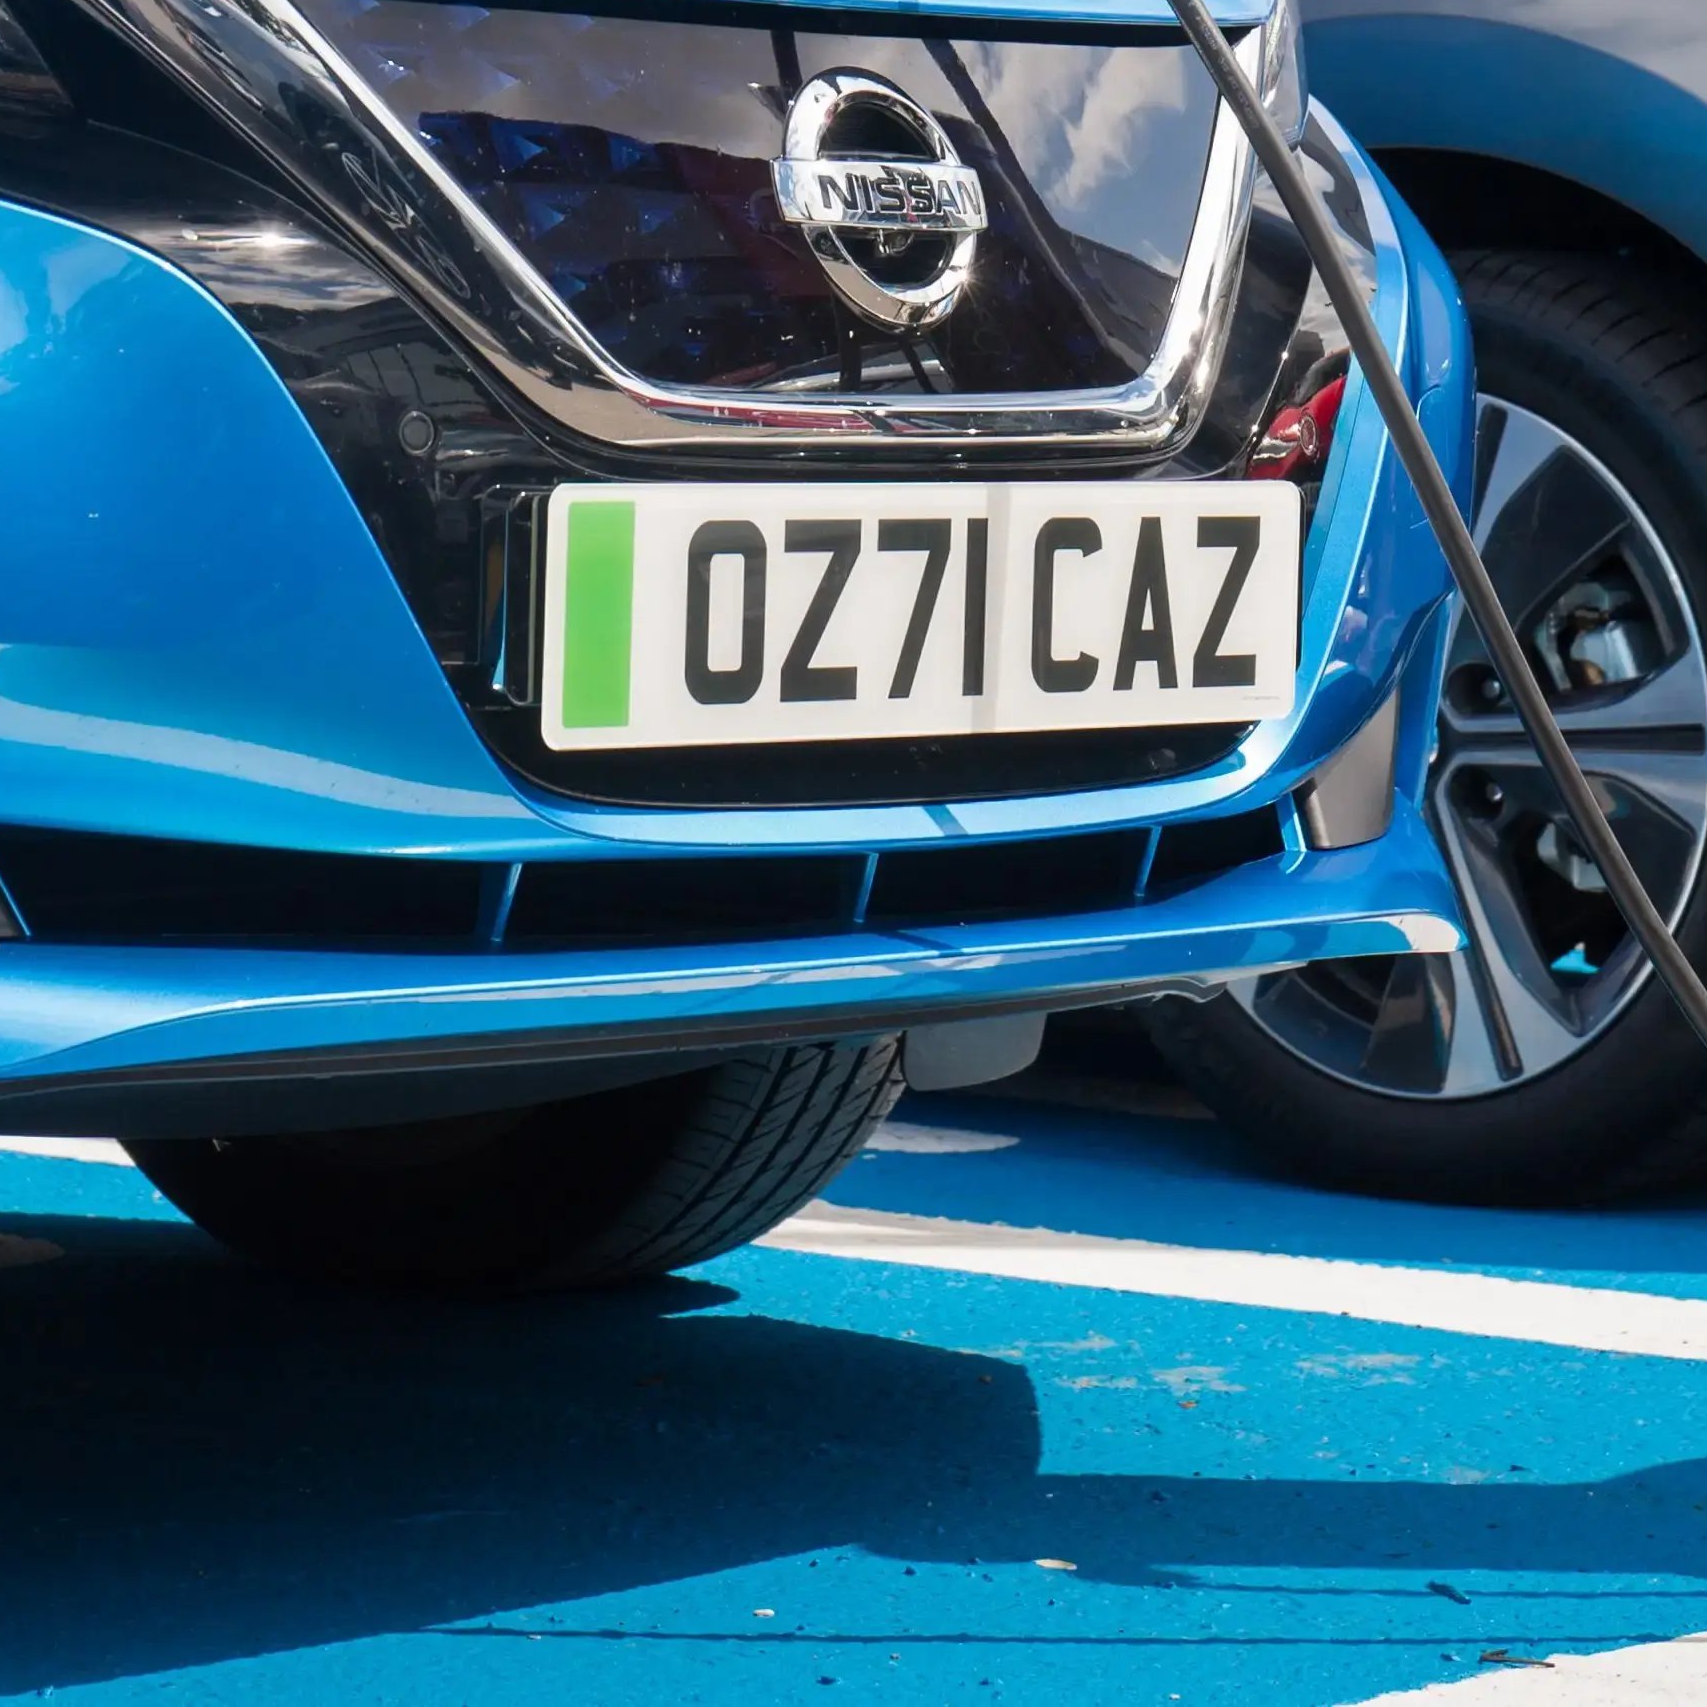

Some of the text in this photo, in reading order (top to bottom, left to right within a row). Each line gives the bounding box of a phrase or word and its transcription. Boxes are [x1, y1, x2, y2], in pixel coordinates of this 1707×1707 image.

[817, 172, 982, 215] NISSAN
[684, 516, 1261, 705] OZ71 CAZ
